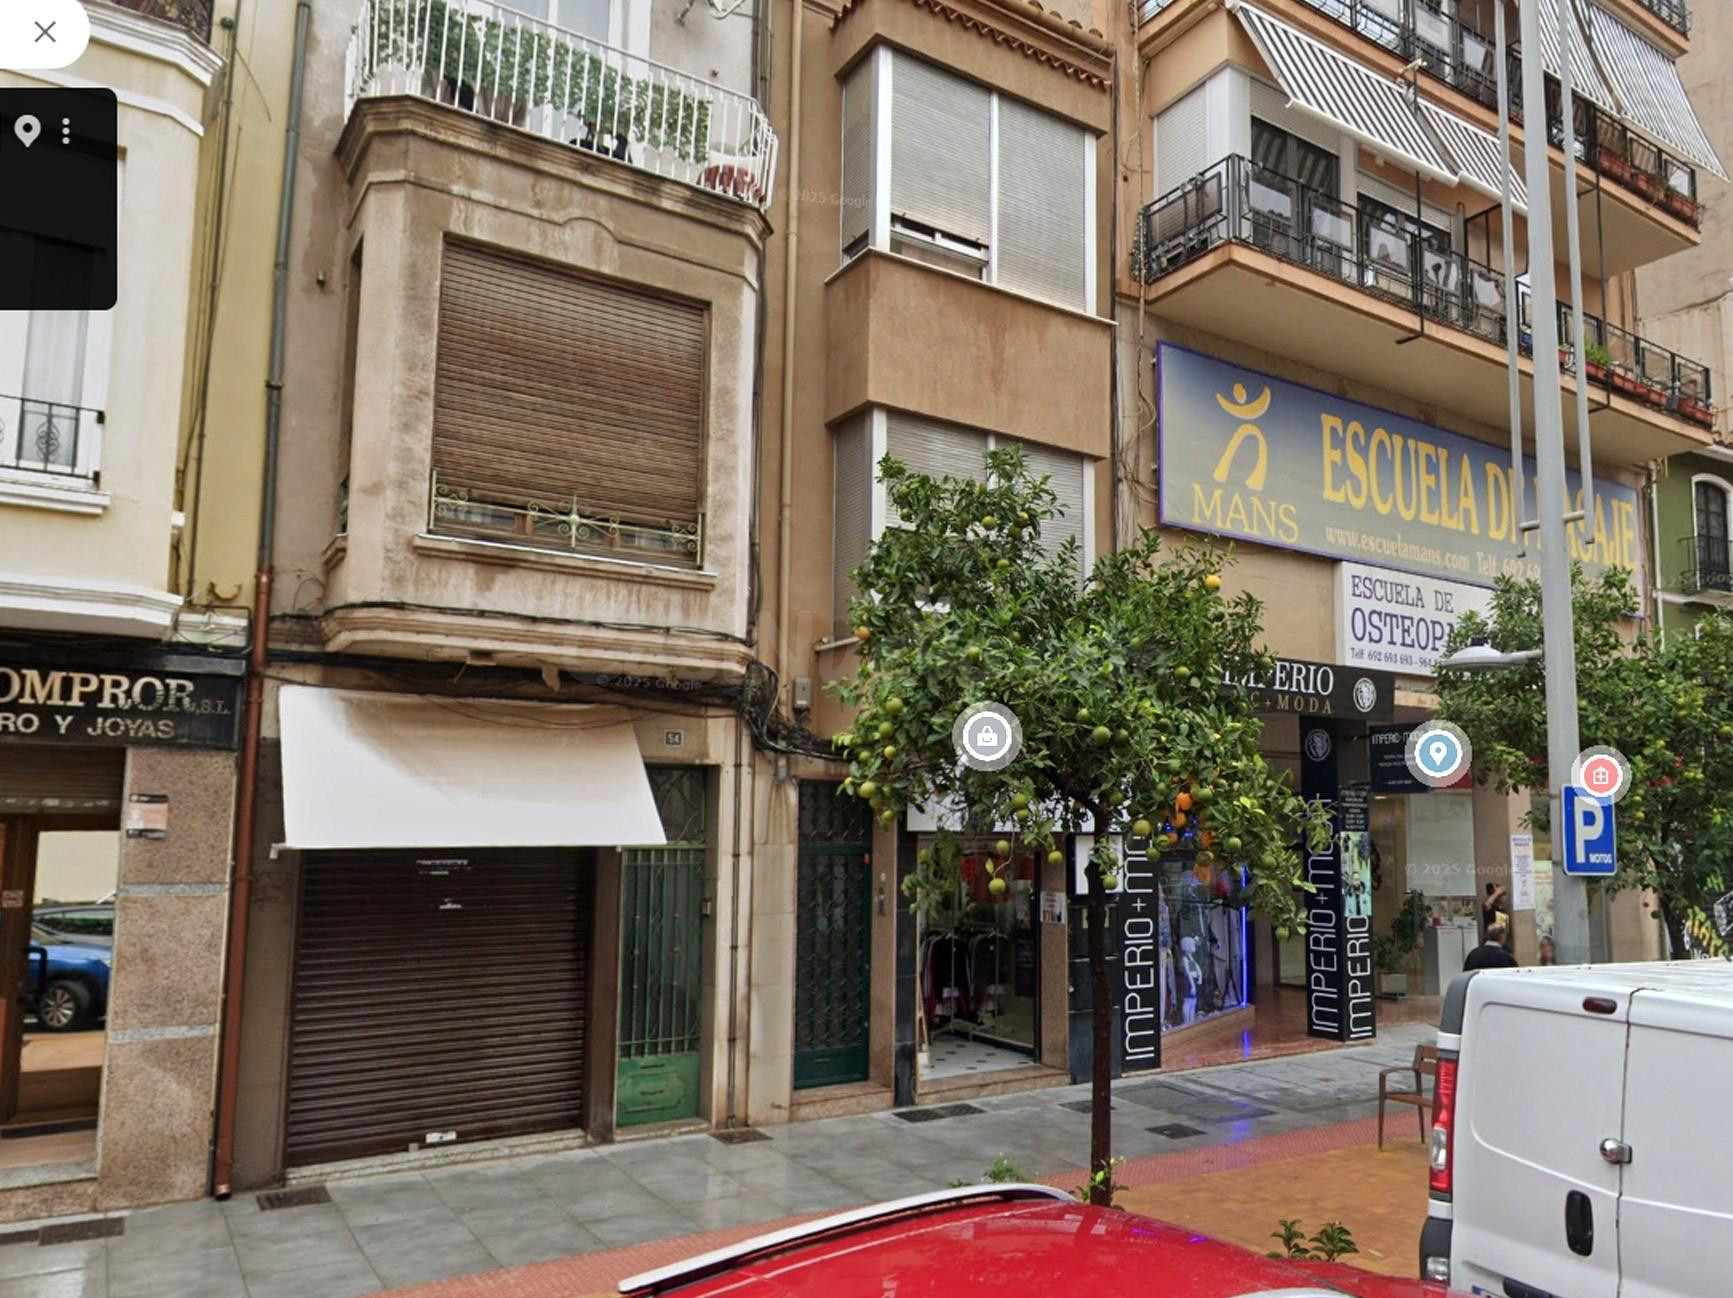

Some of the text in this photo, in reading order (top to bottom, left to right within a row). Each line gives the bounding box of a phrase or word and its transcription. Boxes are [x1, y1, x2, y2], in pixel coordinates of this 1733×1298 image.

[1321, 413, 1479, 536] ESCUELA
[1192, 482, 1299, 543] MANS
[1325, 527, 1470, 572] www.escuelamans.com
[1351, 574, 1454, 613] ESCUELA DE
[1368, 650, 1382, 662] 692
[54, 714, 74, 734] Y
[87, 716, 175, 738] JOYAS
[1277, 694, 1332, 714] MODA
[1574, 796, 1604, 863] P
[1589, 853, 1613, 864] MOTOS
[1125, 918, 1154, 1060] IMPERIO
[1310, 909, 1339, 1033] IMPERIO
[1346, 915, 1374, 1038] IMPERIO
